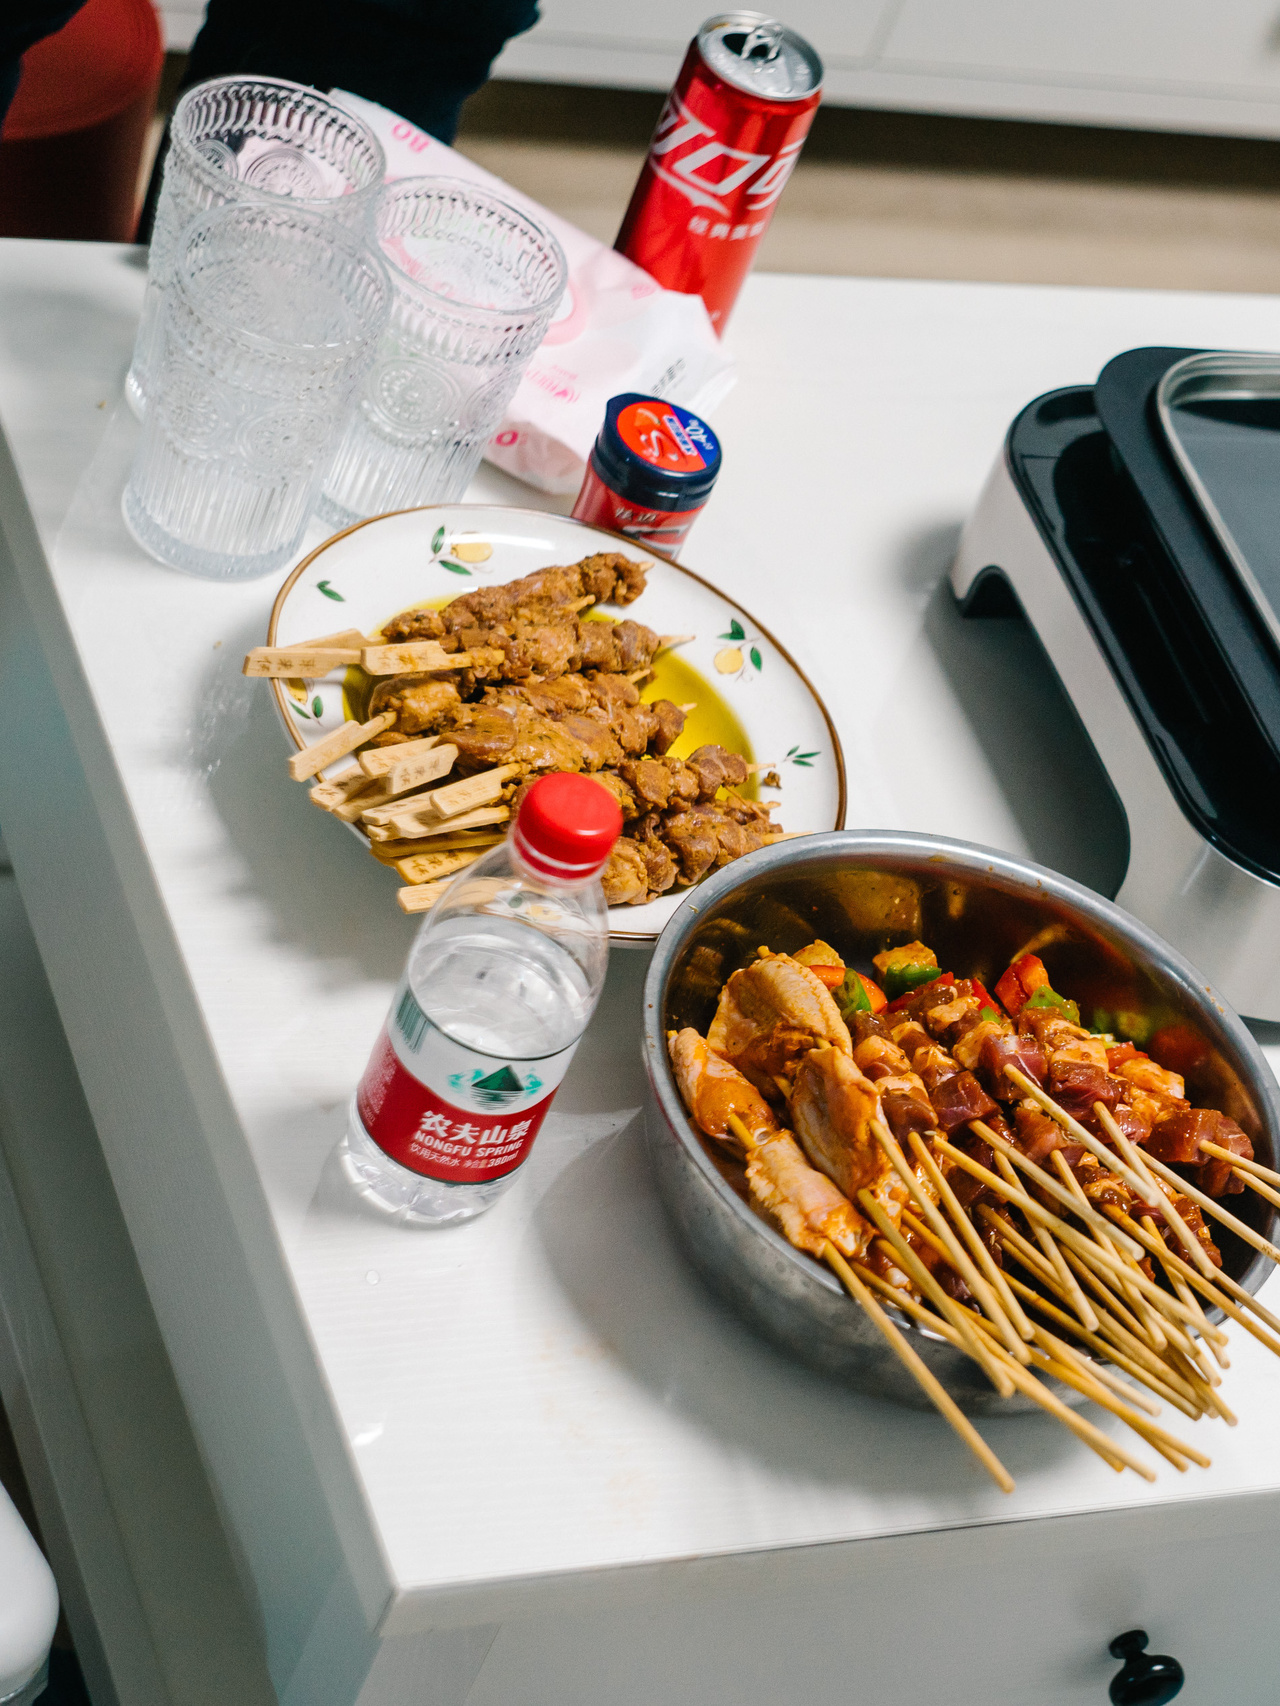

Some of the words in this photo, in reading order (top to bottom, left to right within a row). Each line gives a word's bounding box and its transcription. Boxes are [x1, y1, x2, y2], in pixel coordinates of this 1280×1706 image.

[420, 1110, 533, 1145] 农夫山泉
[409, 1142, 461, 1167] 饮用天然水
[414, 1130, 473, 1157] NONGFU
[476, 1139, 525, 1158] SPRING
